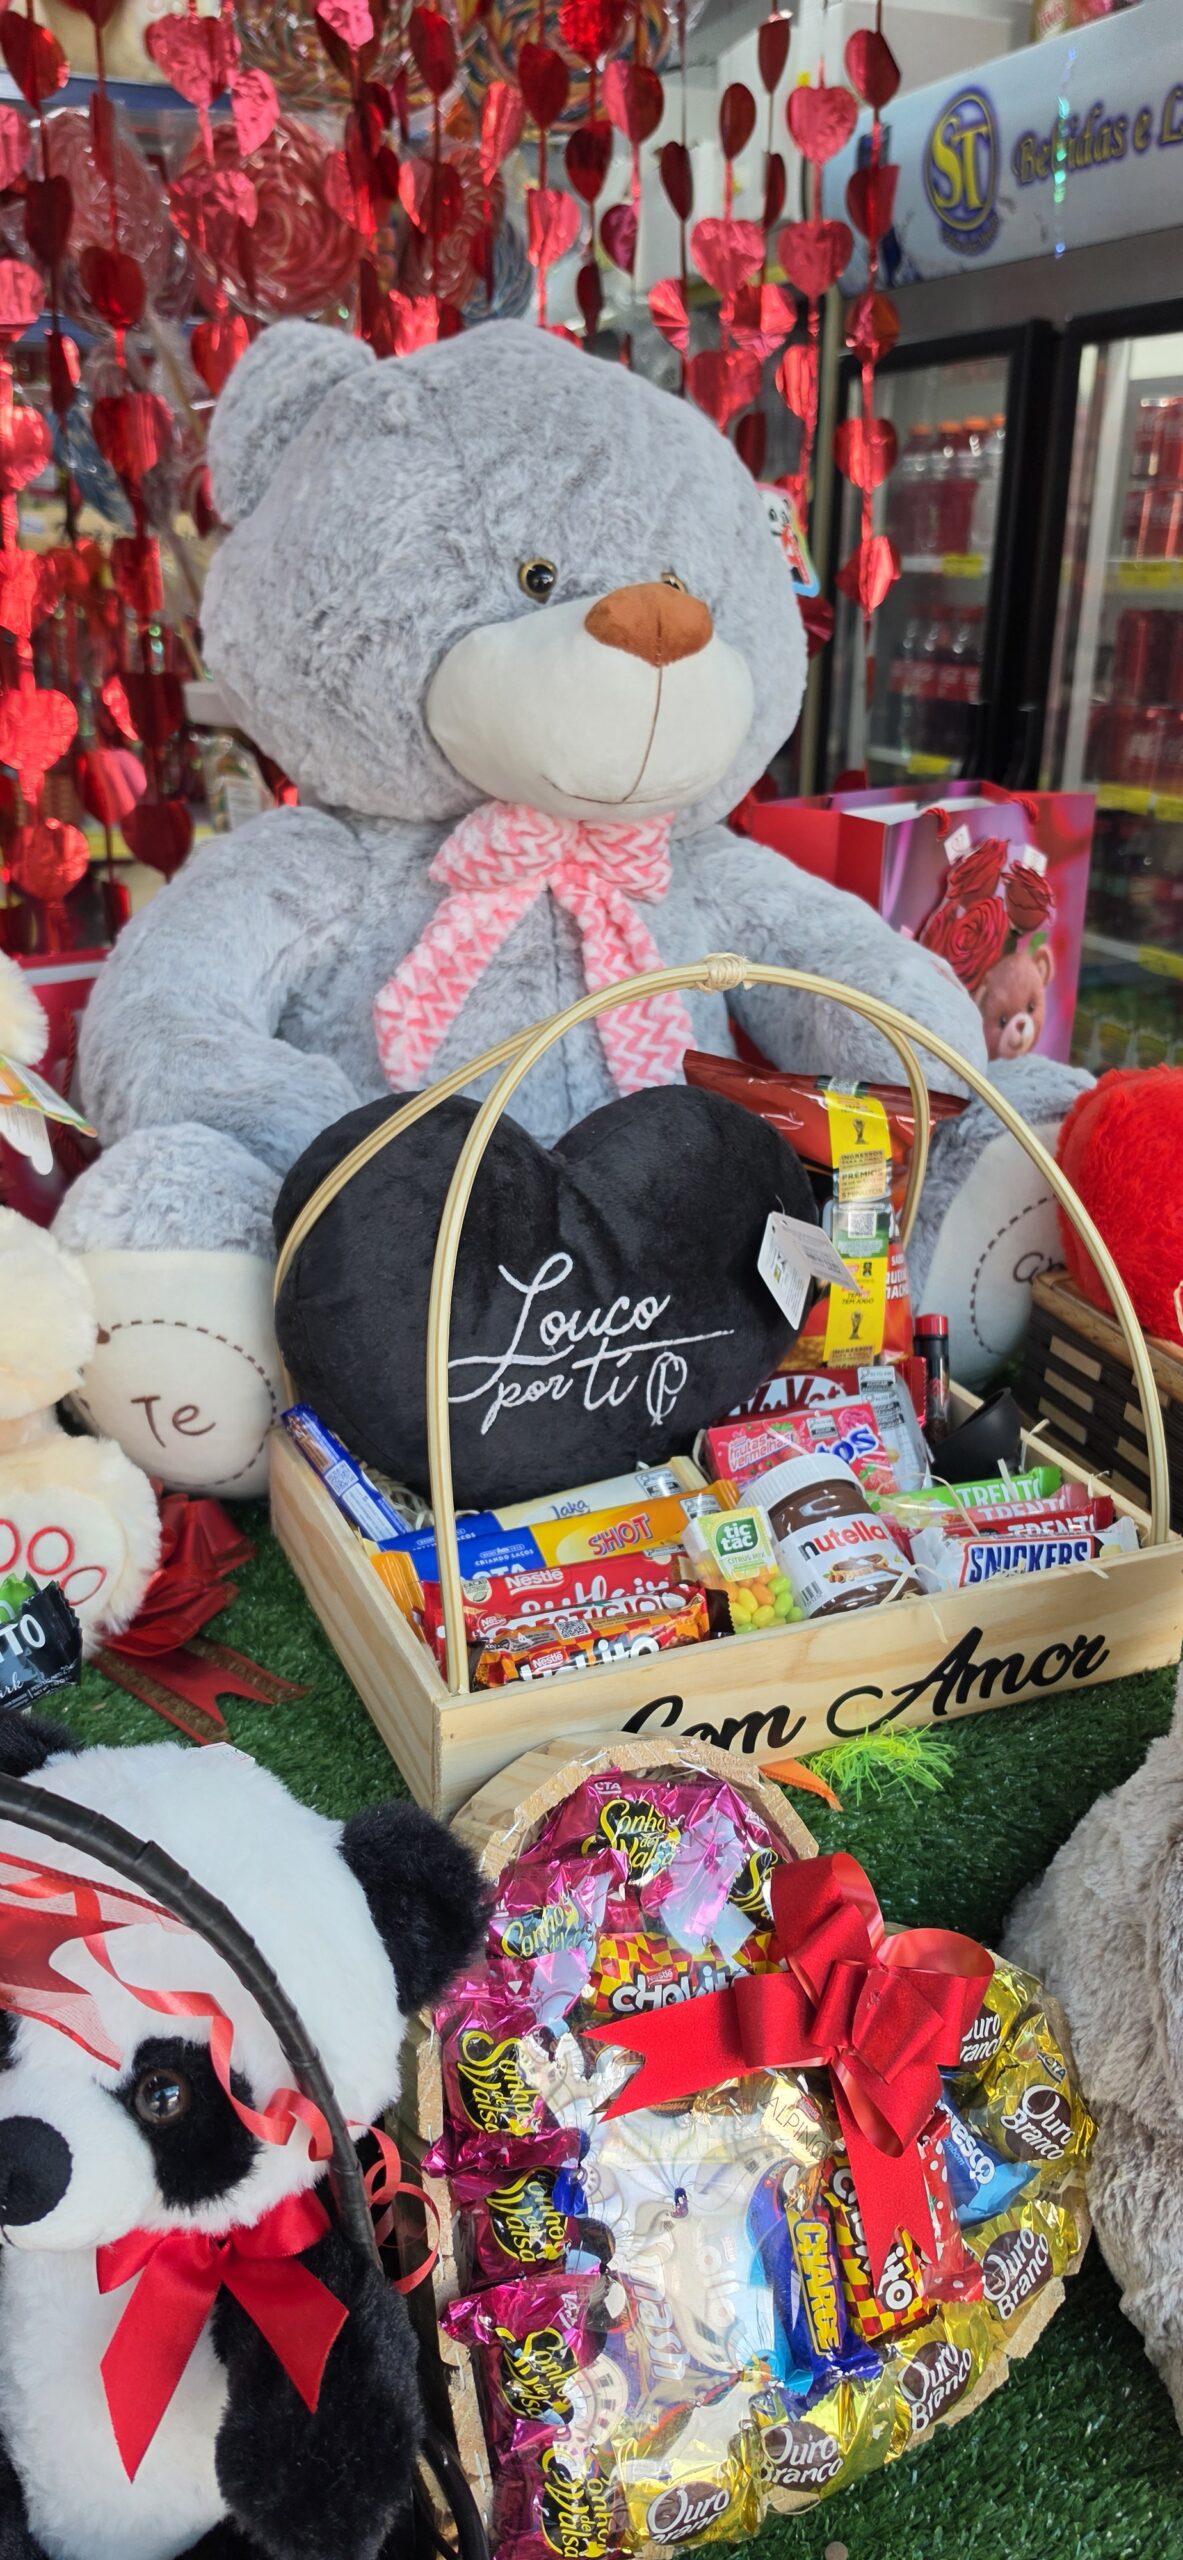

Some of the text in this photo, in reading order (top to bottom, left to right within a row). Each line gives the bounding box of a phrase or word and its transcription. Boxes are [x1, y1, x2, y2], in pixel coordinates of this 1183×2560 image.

[498, 1252, 671, 1365] Louco
[131, 1396, 216, 1448] Te
[480, 1374, 574, 1435] por
[587, 1513, 653, 1556] SHOT
[720, 1534, 754, 1550] tac
[725, 1522, 752, 1539] tic
[800, 1520, 887, 1561] nutella
[969, 1542, 1088, 1583] SNICKERS
[826, 1626, 1112, 1738] Amor
[960, 2036, 1002, 2063] ranco
[961, 2013, 1000, 2042] uro
[764, 2095, 830, 2160] ALPINO
[1001, 2109, 1065, 2160] Branco
[794, 2222, 841, 2351] CHARGE
[982, 2228, 1035, 2300] Ouro
[997, 2232, 1050, 2321] Branco
[899, 2343, 958, 2401] Ouro
[910, 2347, 972, 2433] Branco
[764, 2427, 840, 2467] Ouro
[647, 2488, 730, 2535] Ouro
